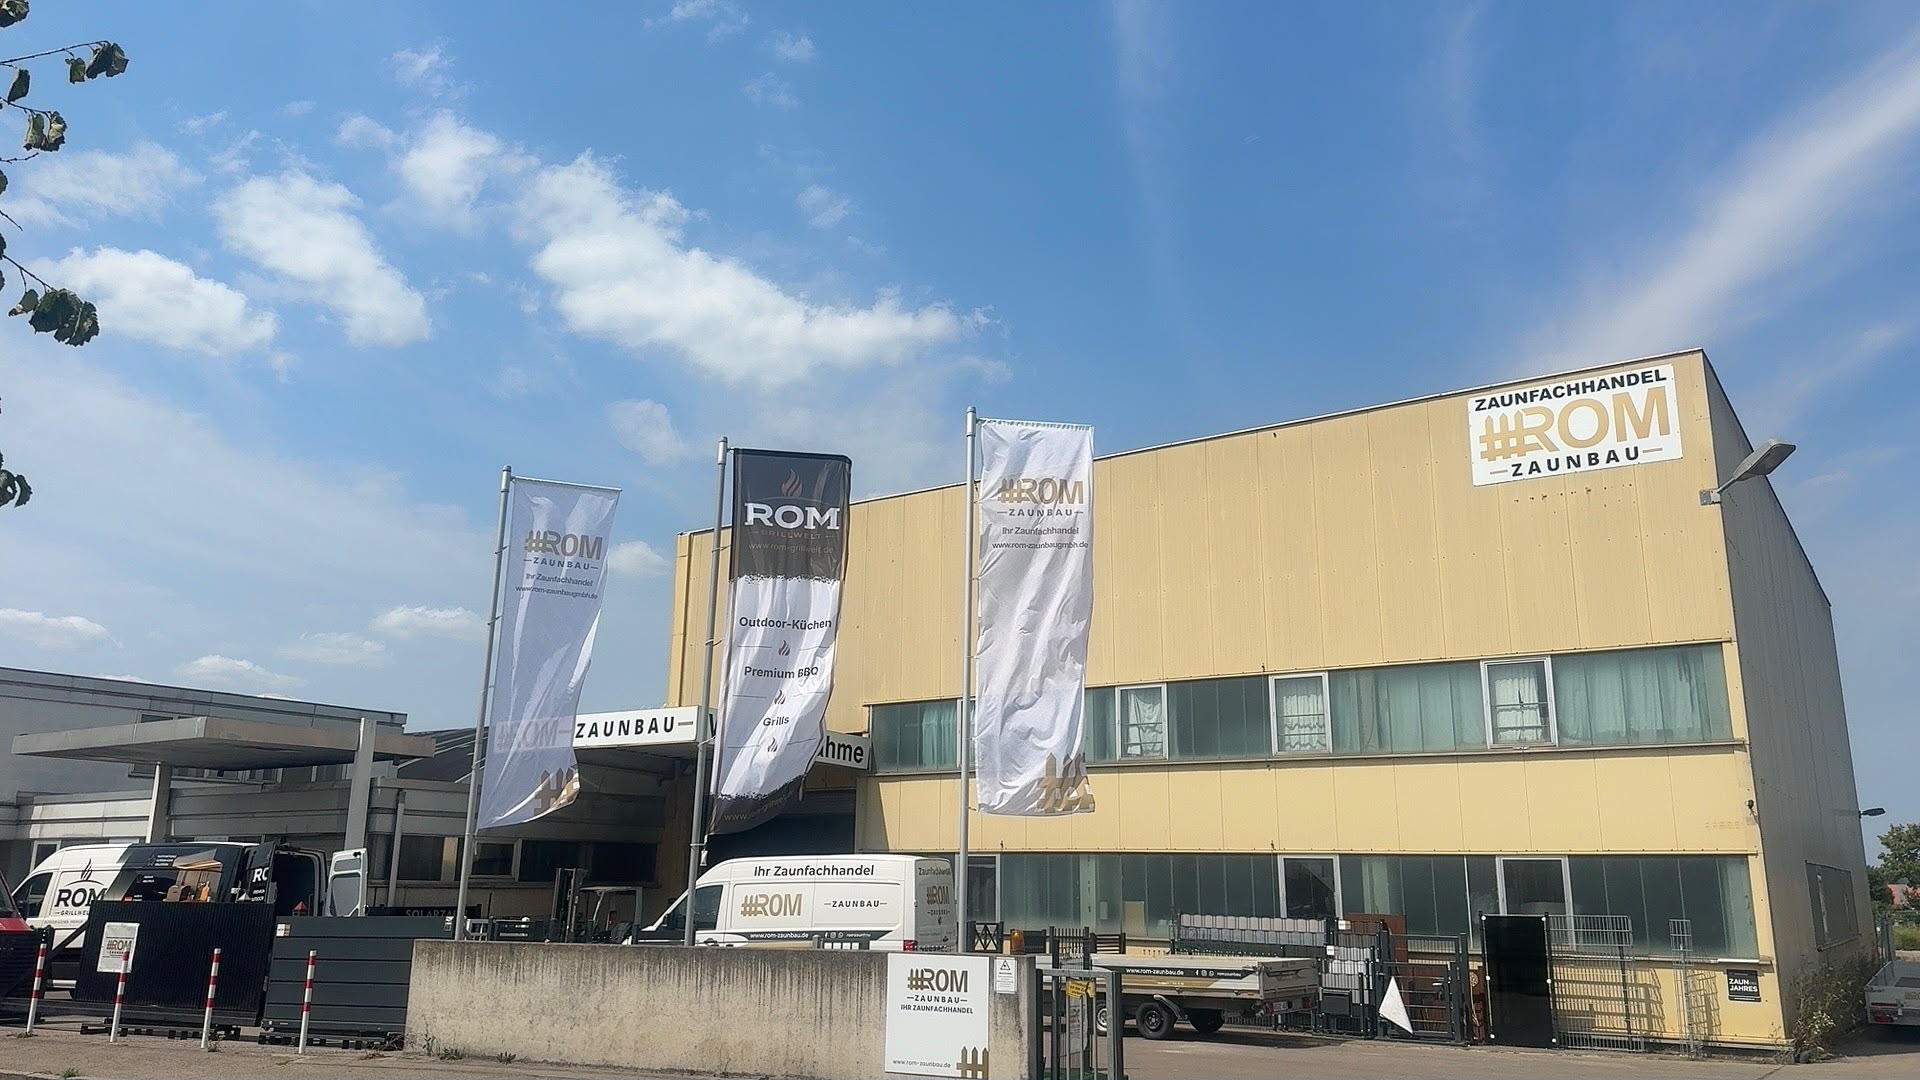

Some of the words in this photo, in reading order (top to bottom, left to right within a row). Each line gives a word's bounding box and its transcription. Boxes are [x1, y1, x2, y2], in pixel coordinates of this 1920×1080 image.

[1474, 368, 1667, 412] ZAUNFACHHANDEL
[1511, 446, 1640, 477] ZAUNBAU
[744, 502, 840, 530] ROM
[1008, 508, 1073, 517] ZAUNBAU
[1002, 527, 1013, 535] Ihr
[1015, 526, 1079, 535] Zaunfachhandel
[533, 557, 590, 570] ZAUNBAU
[739, 616, 832, 631] Outdoor-Küchen
[744, 666, 795, 679] Premium
[797, 666, 819, 678] BBQ
[575, 716, 675, 739] ZAUNBAU
[763, 716, 790, 727] Grills
[753, 865, 771, 877] Ihr
[773, 864, 875, 877] Zaunfachhandel
[832, 900, 880, 908] ZAUNBAU
[914, 995, 960, 1004] ZAUNBAU
[912, 1004, 973, 1014] ZAUNFACHHANDEL
[892, 1059, 951, 1069] www.rom-zaunbau.de
